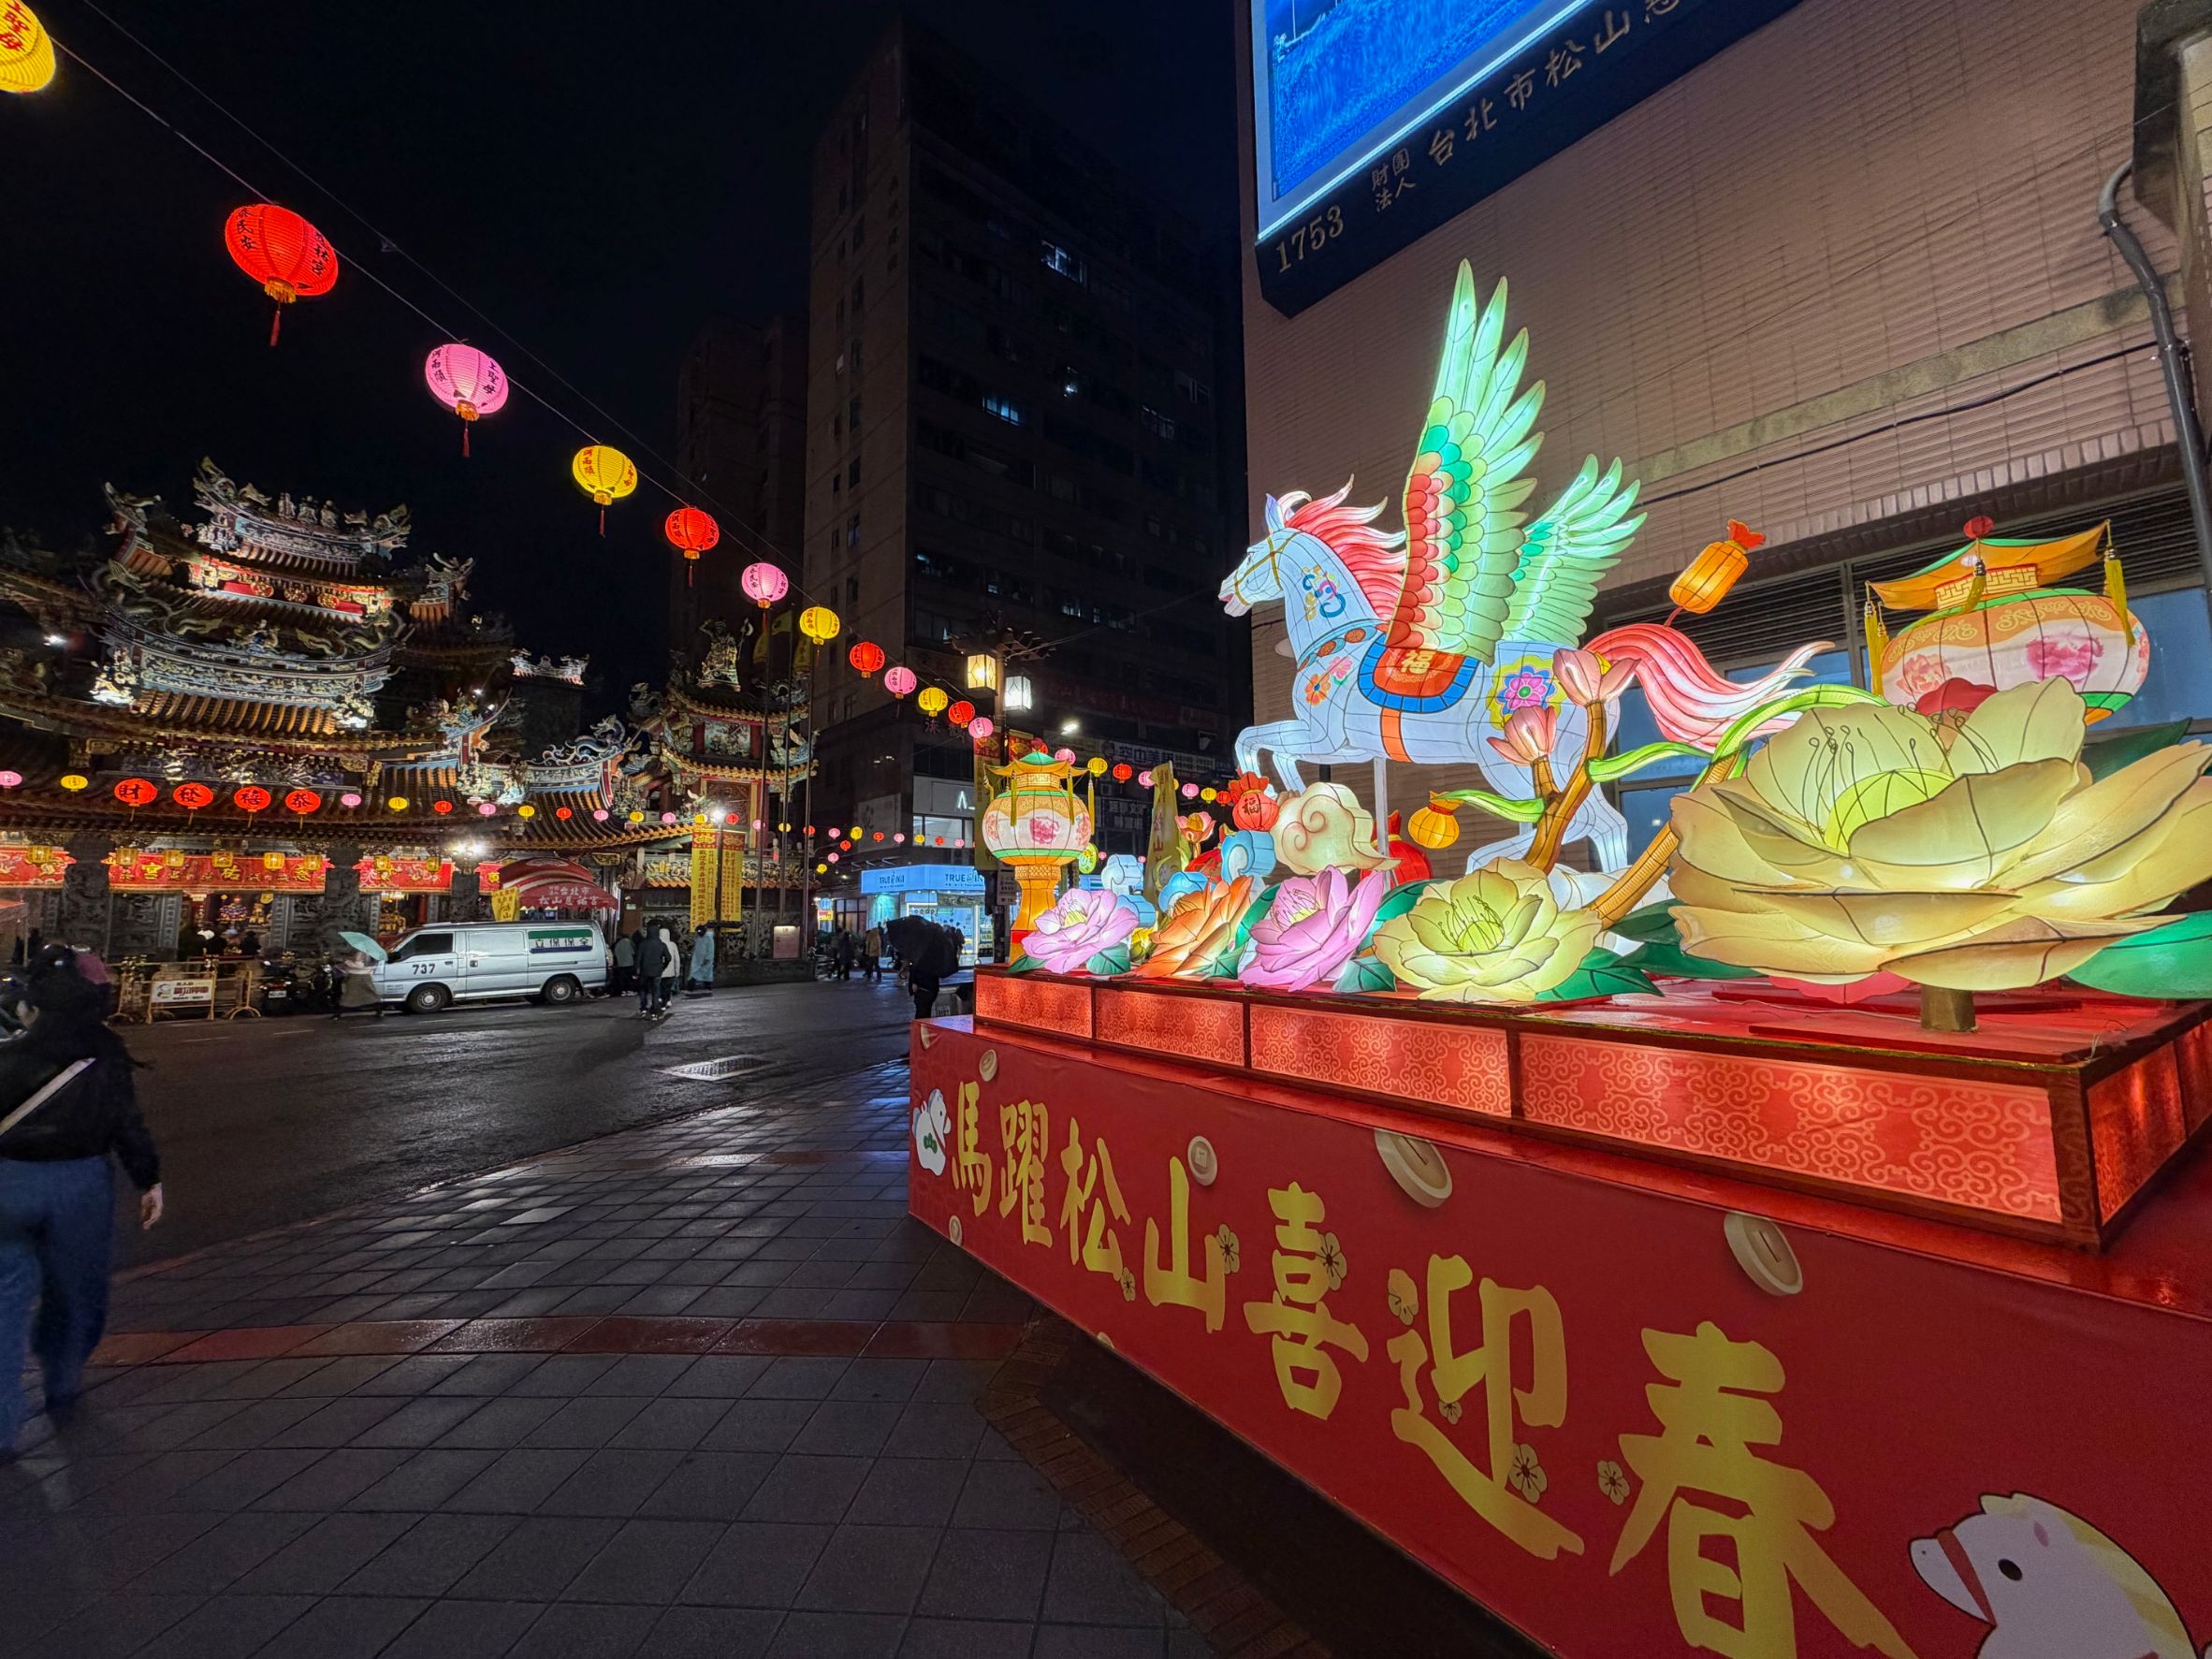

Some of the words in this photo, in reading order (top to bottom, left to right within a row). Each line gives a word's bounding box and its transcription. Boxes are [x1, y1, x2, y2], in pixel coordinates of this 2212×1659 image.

[1374, 178, 1416, 212] 法人
[1275, 205, 1345, 274] 1753
[1400, 648, 1435, 675] 福
[119, 783, 144, 800] 財
[179, 786, 203, 803] 發
[291, 793, 313, 808] 恭
[1242, 796, 1261, 816] 福
[412, 963, 436, 975] 737
